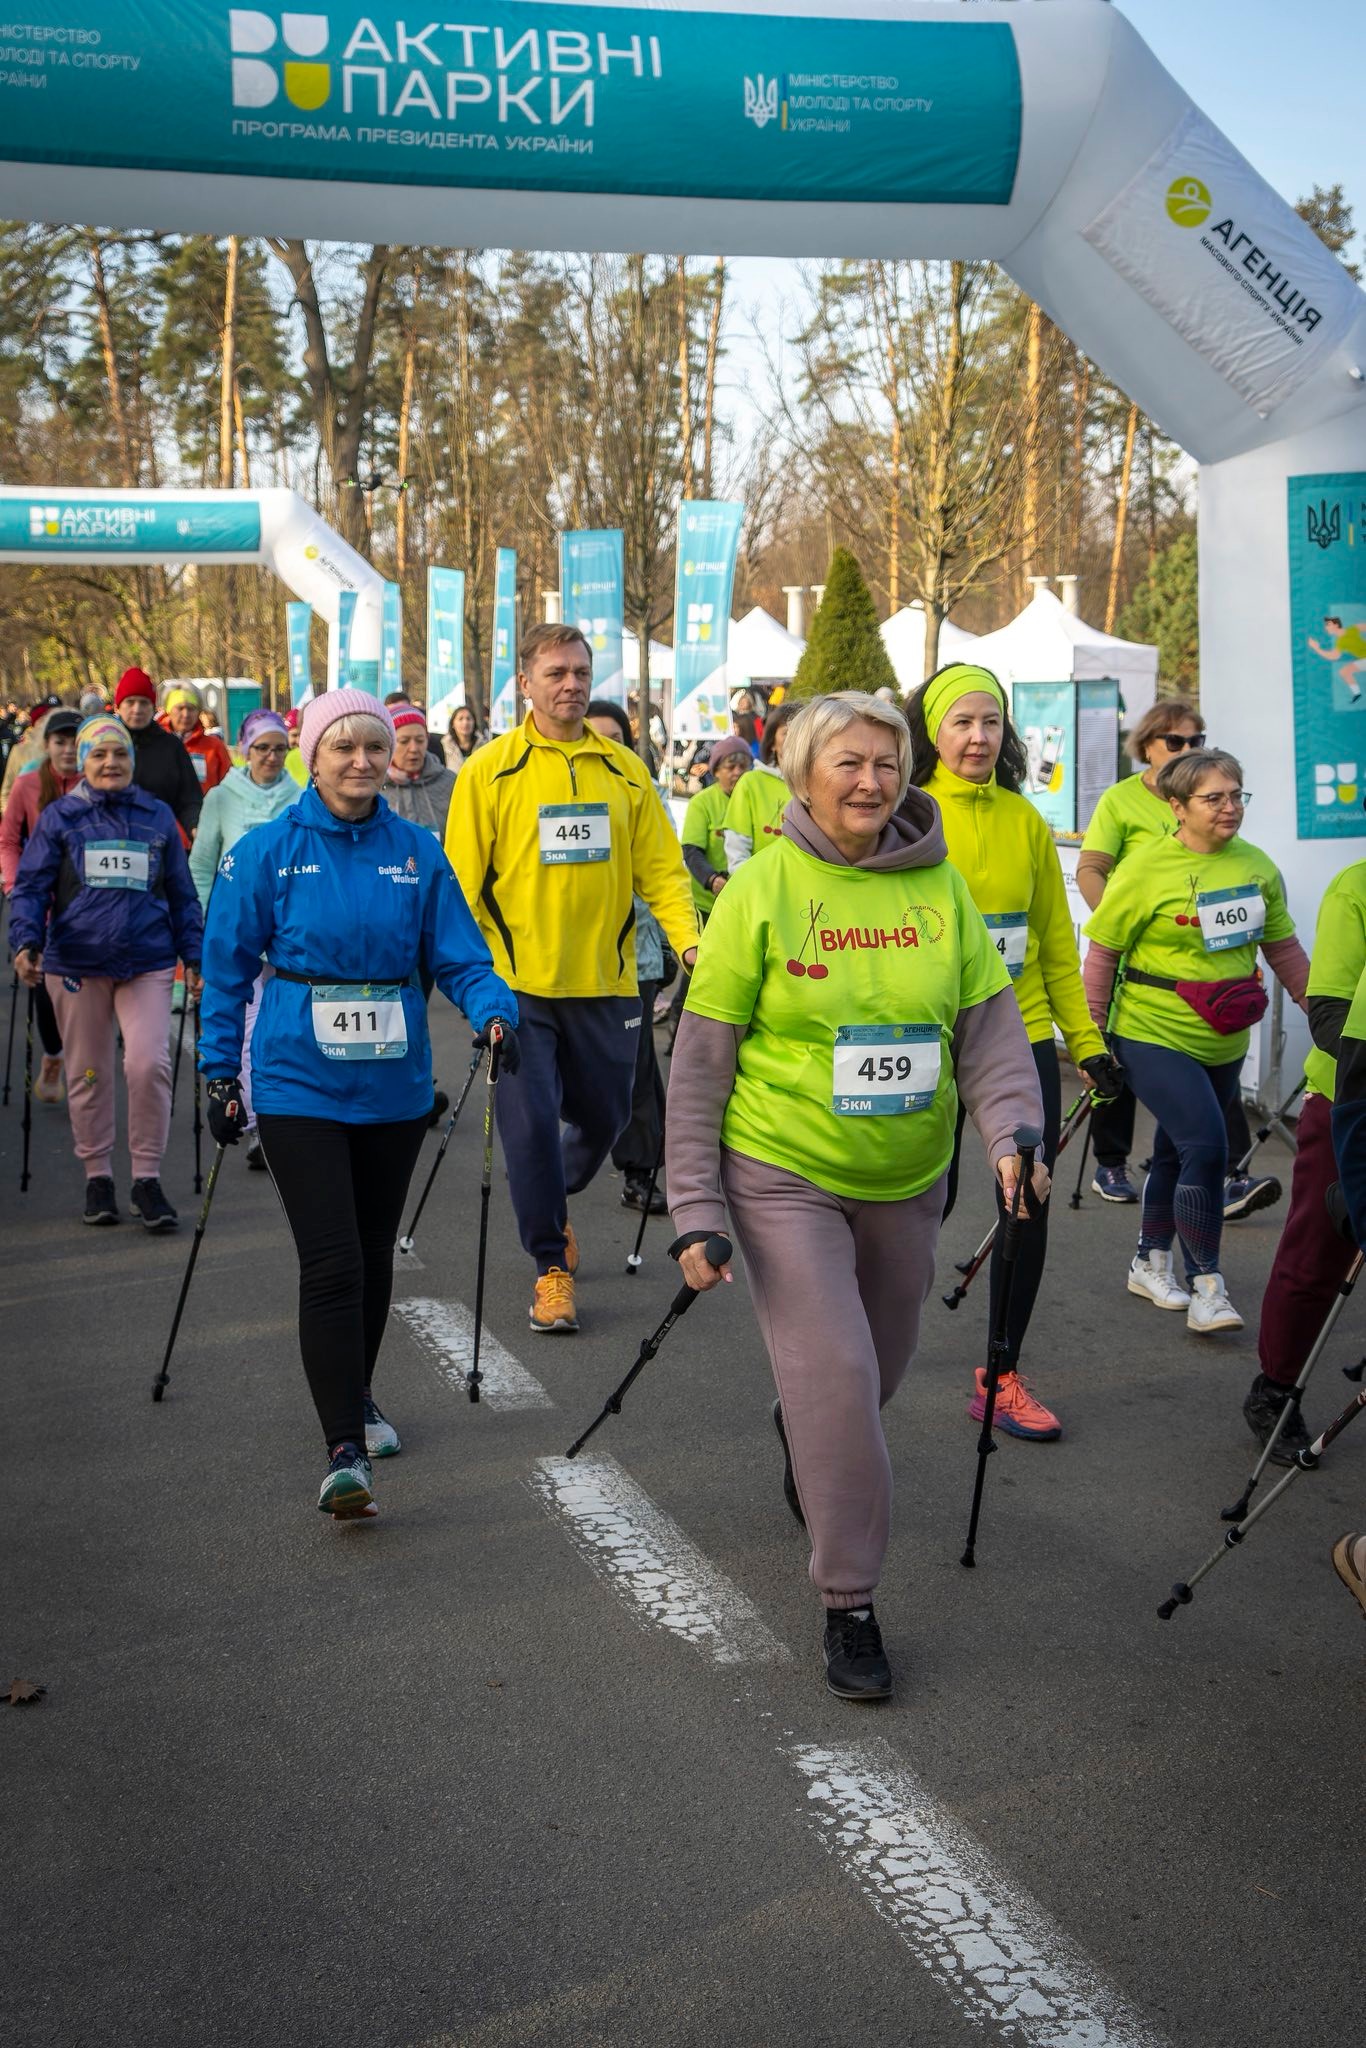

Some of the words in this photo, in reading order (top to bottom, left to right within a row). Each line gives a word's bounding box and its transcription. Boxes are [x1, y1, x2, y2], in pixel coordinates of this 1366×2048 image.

[342, 17, 663, 79] АКТИВНІ
[48, 49, 70, 66] ТА
[71, 51, 140, 71] СПОРТУ
[789, 73, 899, 90] МІНІСТЕРСТВО
[342, 63, 596, 128] ПАРКИ
[789, 96, 849, 112] МОЛОДІ
[852, 97, 873, 110] ТА
[873, 99, 933, 113] СПОРТУ
[789, 116, 850, 133] УКРАЇНИ
[231, 119, 352, 142] ПРОГРАМА
[356, 126, 500, 151] ПРЕЗИДЕНТА
[504, 134, 594, 155] УКРАЇНИ
[1210, 218, 1323, 333] АГЕНЦІЯ
[61, 507, 155, 523] АКТИВНІ
[61, 522, 136, 537] ПАРКИ
[556, 824, 591, 840] 445
[99, 856, 131, 870] 415
[378, 865, 403, 875] Guide
[391, 874, 419, 885] Walker
[1215, 907, 1248, 926] 460
[819, 926, 919, 951] ВИШНЯ
[333, 1011, 377, 1032] 411
[858, 1056, 911, 1081] 459
